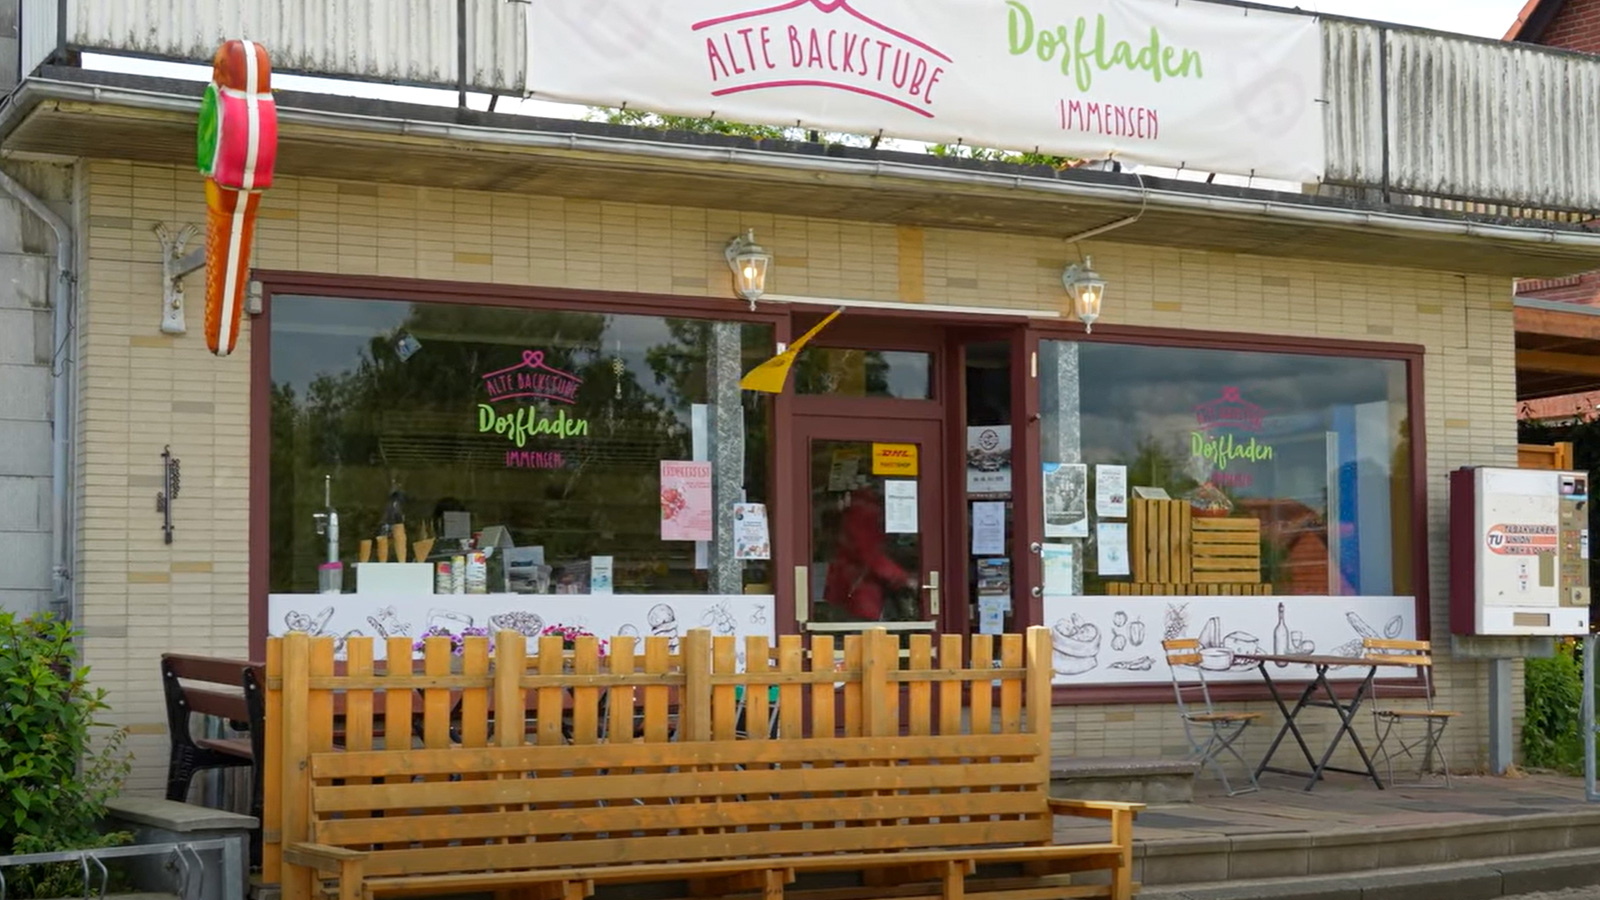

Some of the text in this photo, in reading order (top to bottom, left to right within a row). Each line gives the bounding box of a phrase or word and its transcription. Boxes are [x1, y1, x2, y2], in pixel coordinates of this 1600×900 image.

[706, 25, 945, 104] ALTE BACKSTUBE
[1005, 0, 1203, 93] Dorfladen
[1060, 98, 1159, 140] IMMENSEN
[485, 374, 514, 397] ALTE
[478, 403, 588, 448] Dorfladen
[506, 450, 563, 469] IMMENSEN
[881, 449, 909, 457] DHL
[1191, 431, 1273, 470] Dorfladen
[1489, 534, 1503, 545] TU
